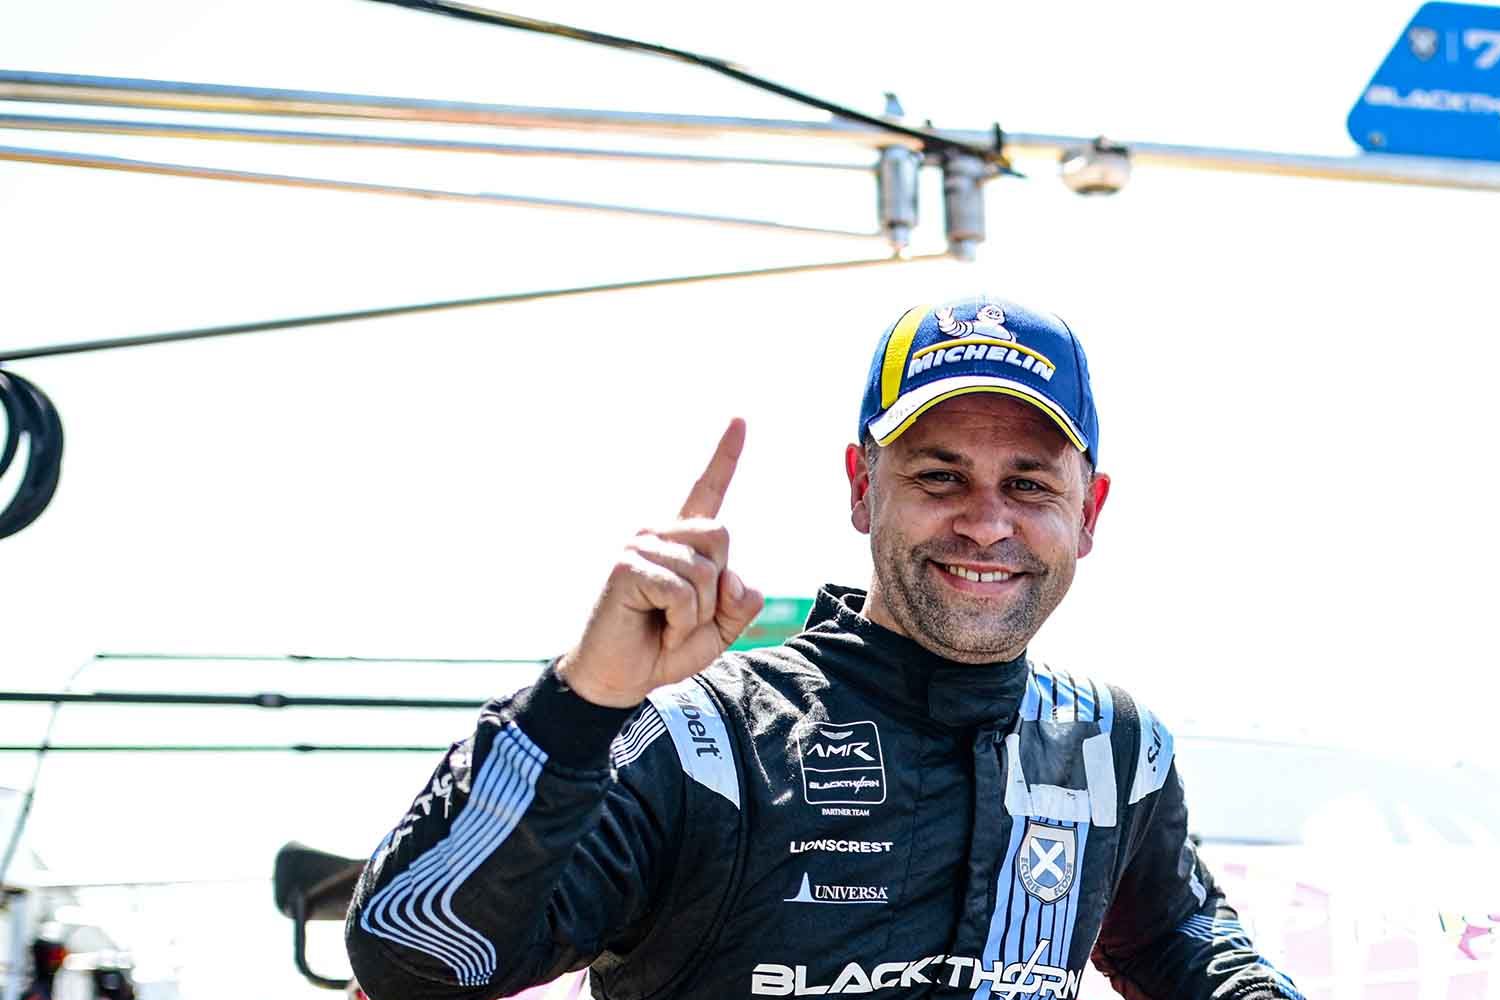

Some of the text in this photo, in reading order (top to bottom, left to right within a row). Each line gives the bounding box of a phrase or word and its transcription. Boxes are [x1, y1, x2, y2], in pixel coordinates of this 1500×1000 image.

[907, 344, 1055, 382] MICHELIN
[806, 742, 876, 761] AMR
[809, 775, 880, 795] BLACKTHORN
[822, 808, 870, 816] PARTNER TEAM
[789, 839, 894, 854] LIONSCREST
[1020, 856, 1041, 895] ECURIE
[815, 884, 888, 900] UNIVERSA
